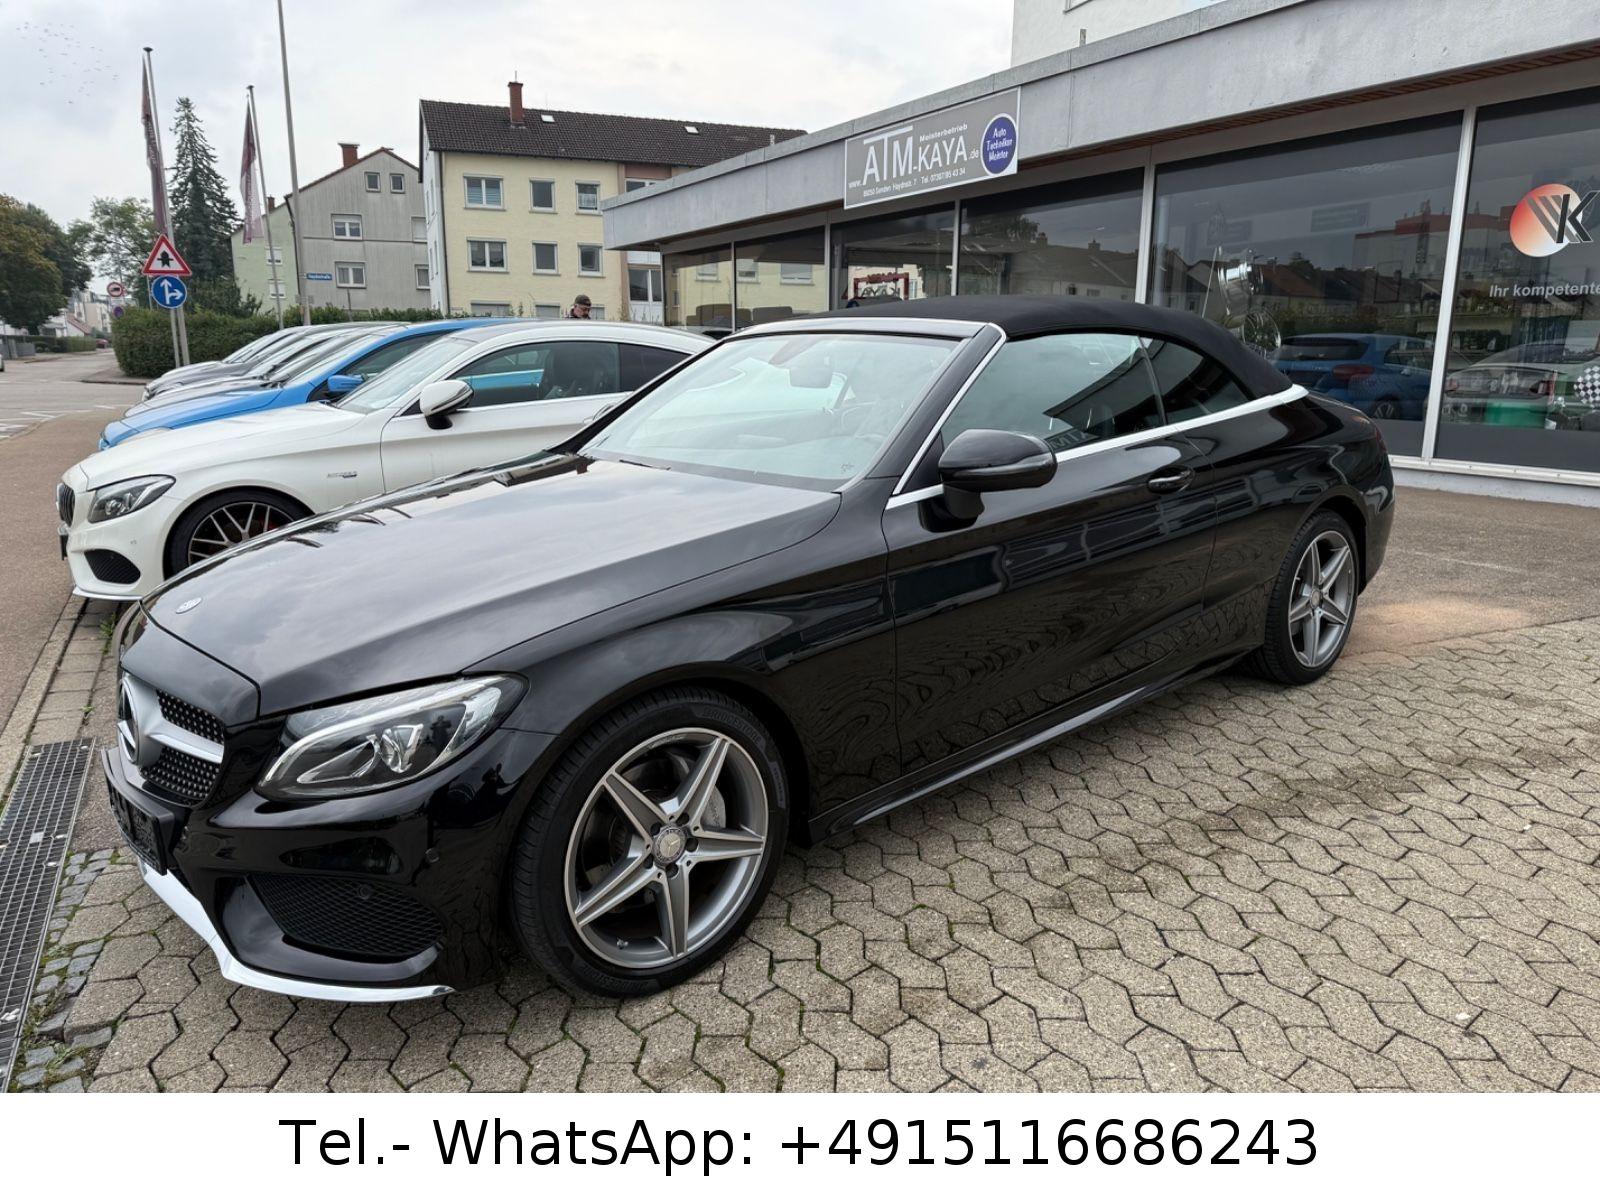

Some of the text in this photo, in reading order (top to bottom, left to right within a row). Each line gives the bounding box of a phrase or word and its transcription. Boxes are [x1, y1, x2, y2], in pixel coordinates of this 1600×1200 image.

[919, 123, 968, 143] Meisterbetrieb
[993, 127, 1007, 138] Auto
[988, 150, 1009, 162] Meister
[1490, 285, 1509, 297] Ihr
